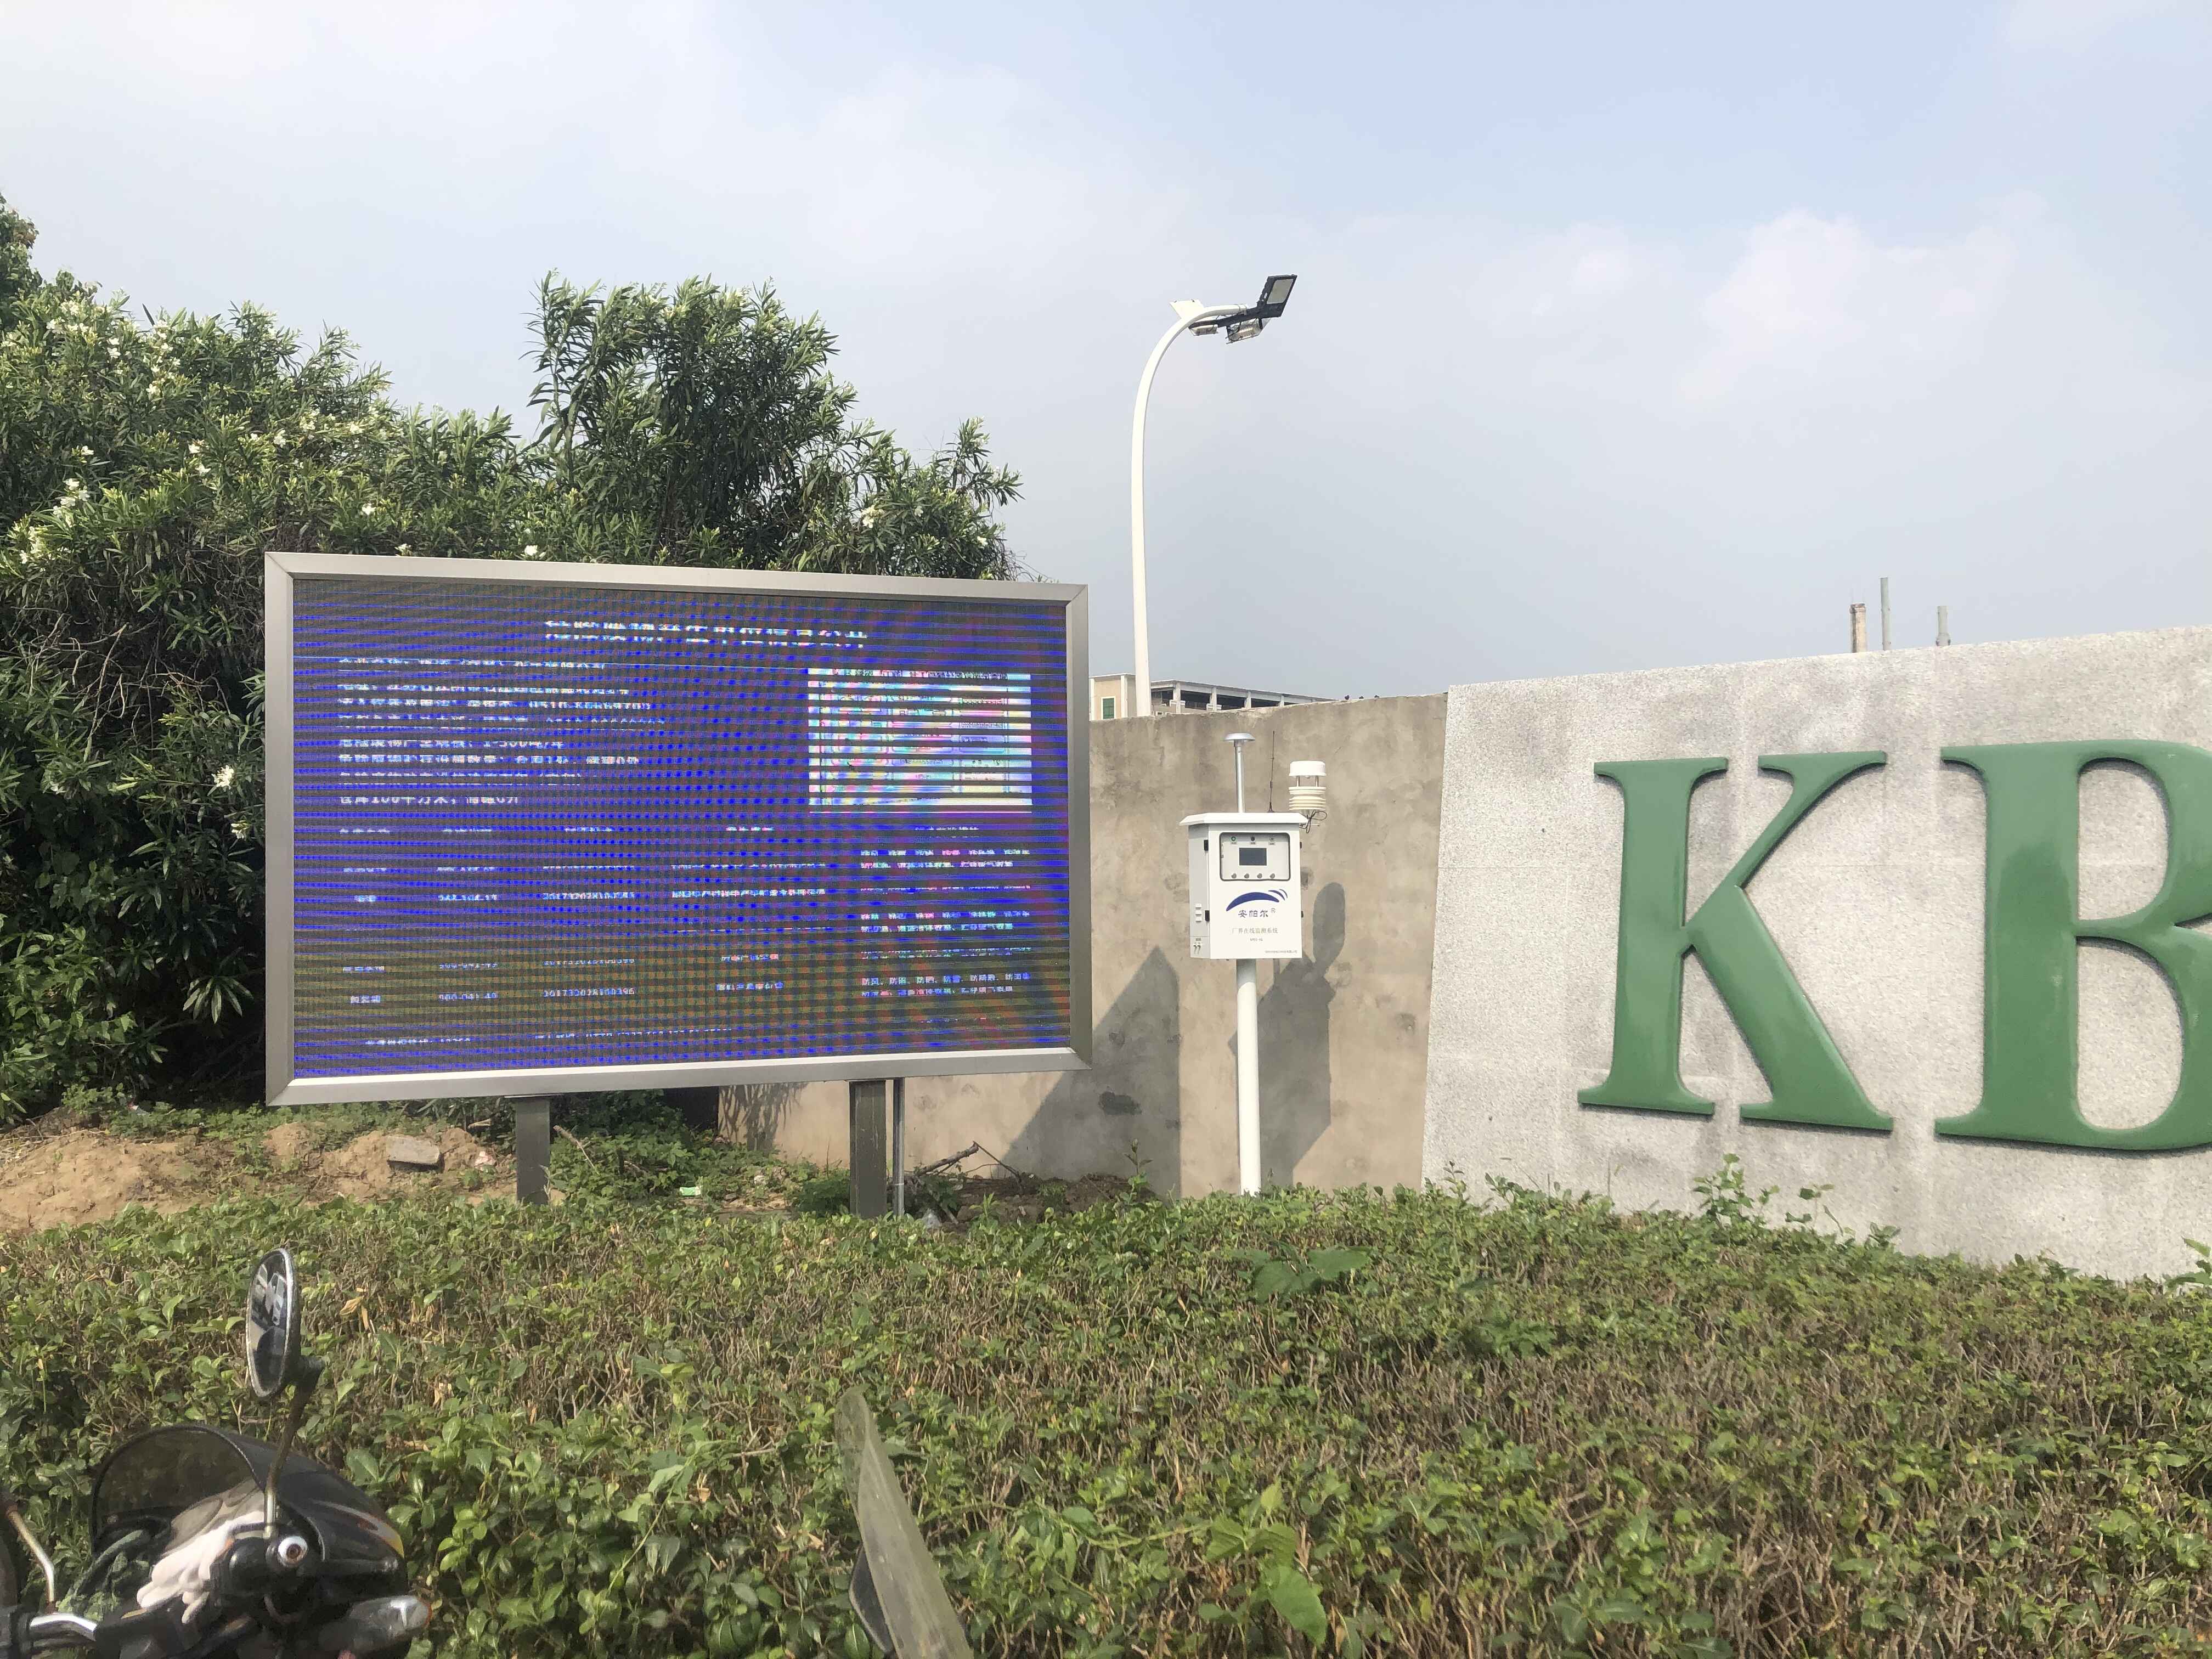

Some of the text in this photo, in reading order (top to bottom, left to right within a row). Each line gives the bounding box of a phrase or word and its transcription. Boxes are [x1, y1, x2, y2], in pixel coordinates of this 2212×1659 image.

[1238, 910, 1268, 918] 安帕尔
[1577, 738, 2212, 1152] KB
